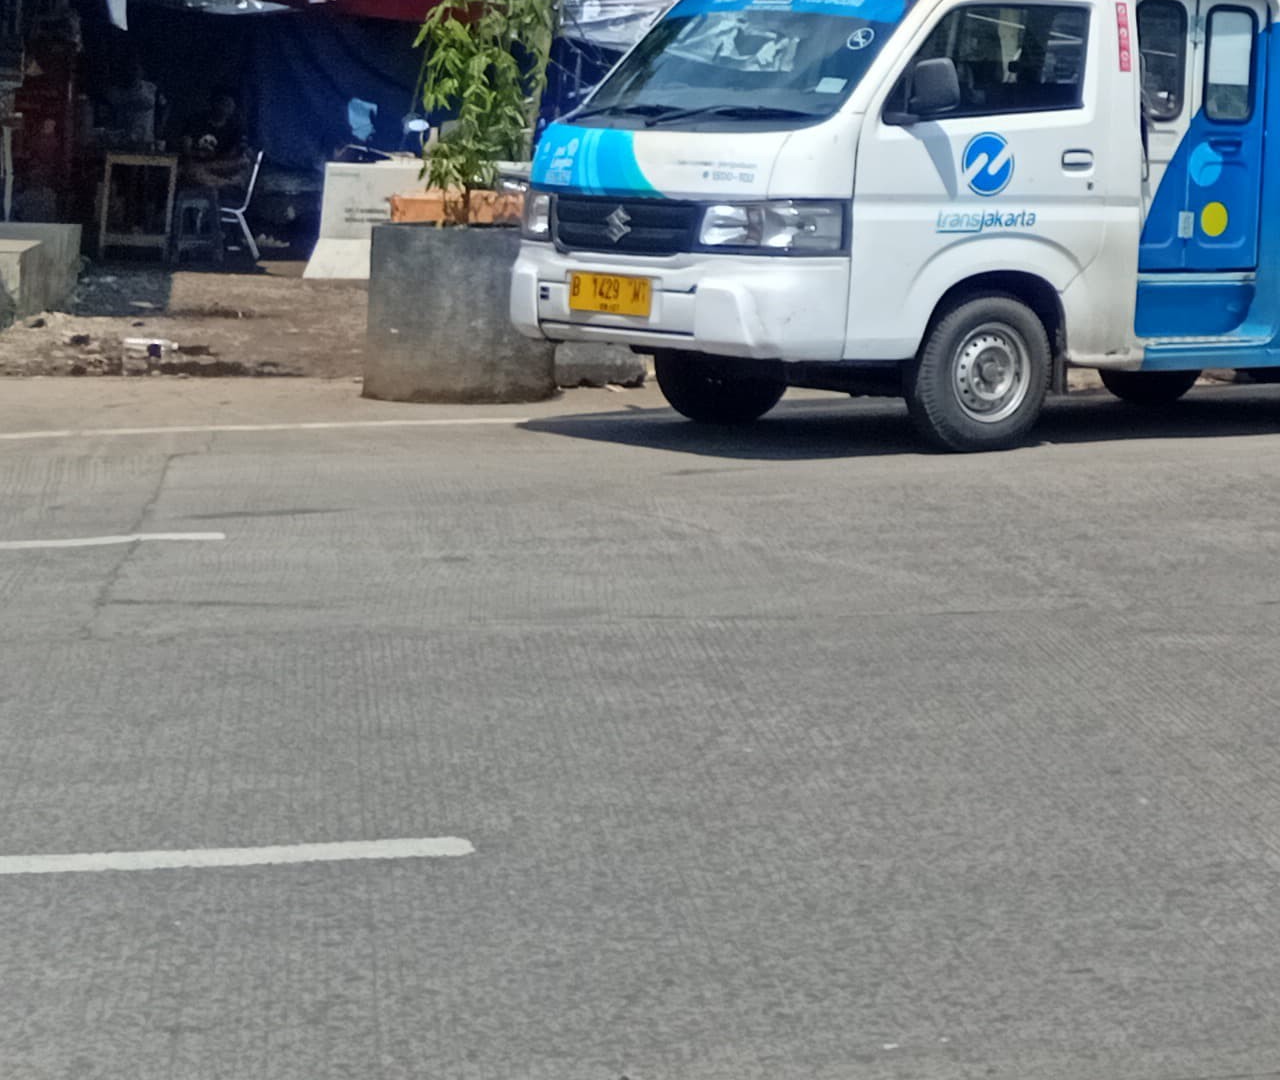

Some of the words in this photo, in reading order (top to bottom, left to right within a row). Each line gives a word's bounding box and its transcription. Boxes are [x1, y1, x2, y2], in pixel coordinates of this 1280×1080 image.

[935, 209, 1037, 234] transjakarta
[572, 275, 581, 297] B
[592, 277, 620, 300] 1429
